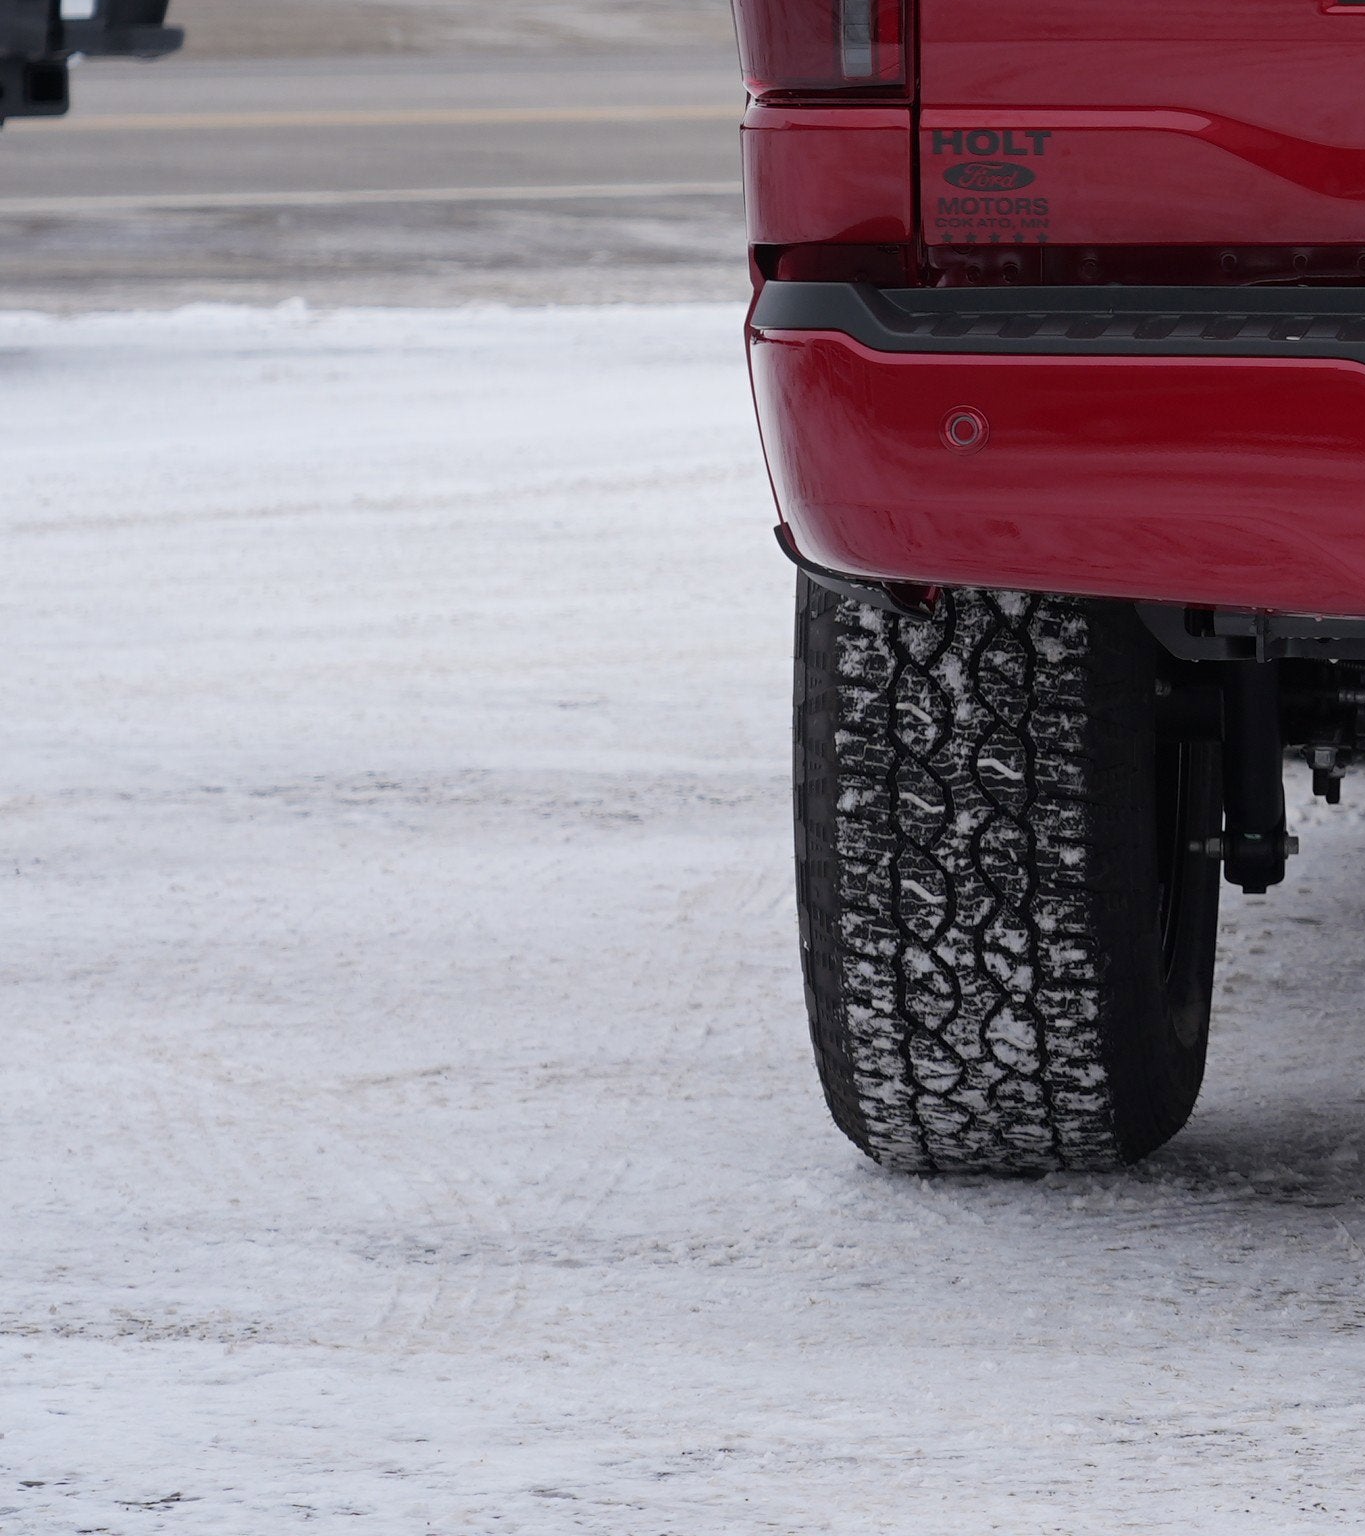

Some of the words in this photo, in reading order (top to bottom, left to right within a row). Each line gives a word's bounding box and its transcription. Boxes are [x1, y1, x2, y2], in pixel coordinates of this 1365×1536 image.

[932, 129, 1051, 156] HOLT
[959, 163, 1021, 188] Ford
[938, 197, 1049, 216] MOTORS
[1020, 217, 1050, 229] MN
